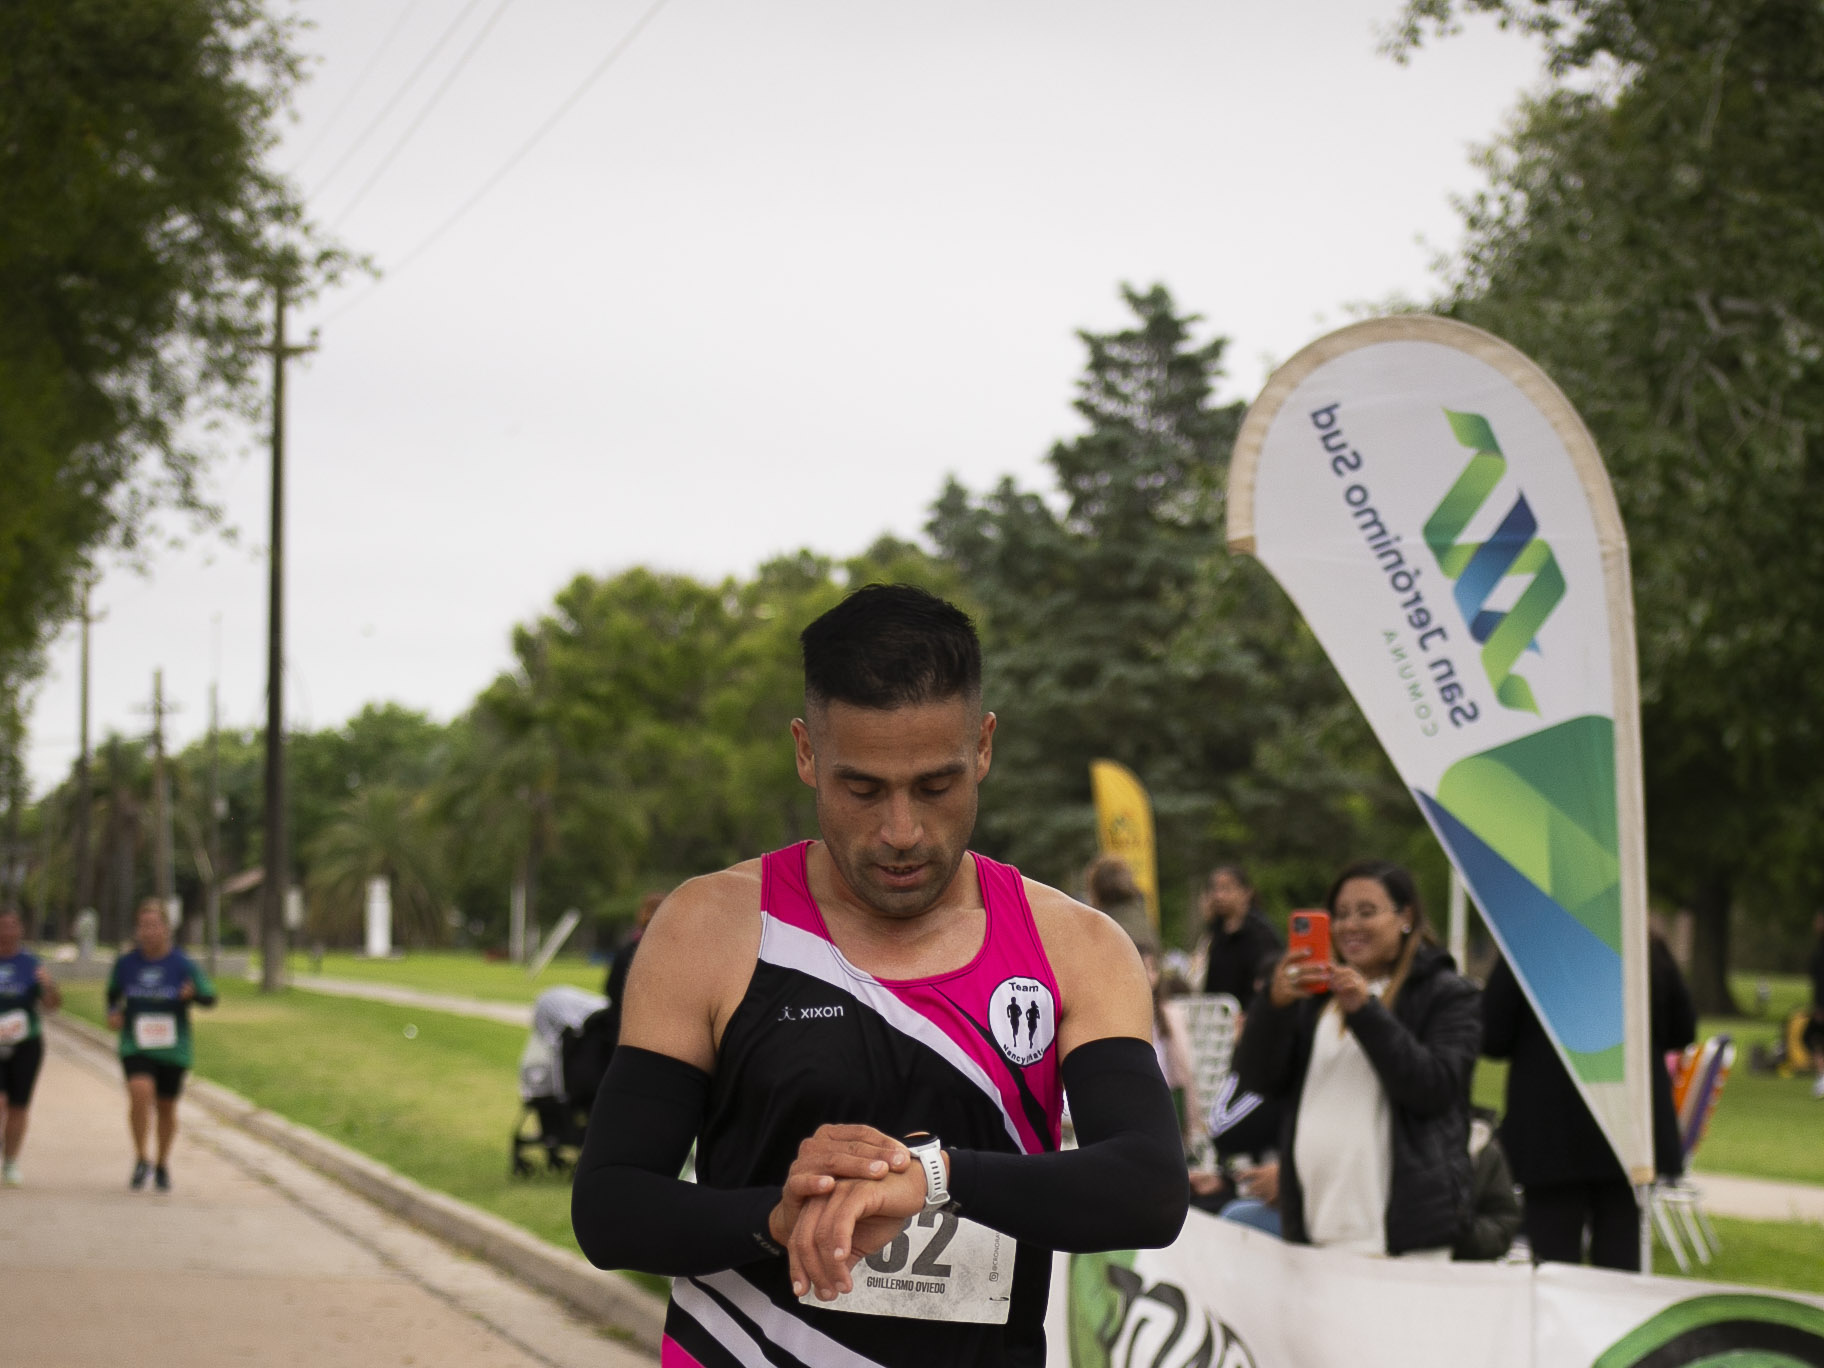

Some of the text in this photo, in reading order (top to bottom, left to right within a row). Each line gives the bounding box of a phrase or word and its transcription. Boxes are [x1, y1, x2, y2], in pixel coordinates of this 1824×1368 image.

[1008, 982, 1040, 993] Team
[800, 1005, 844, 1020] xixon
[866, 1275, 946, 1295] GUILLERMO OVIEDO
